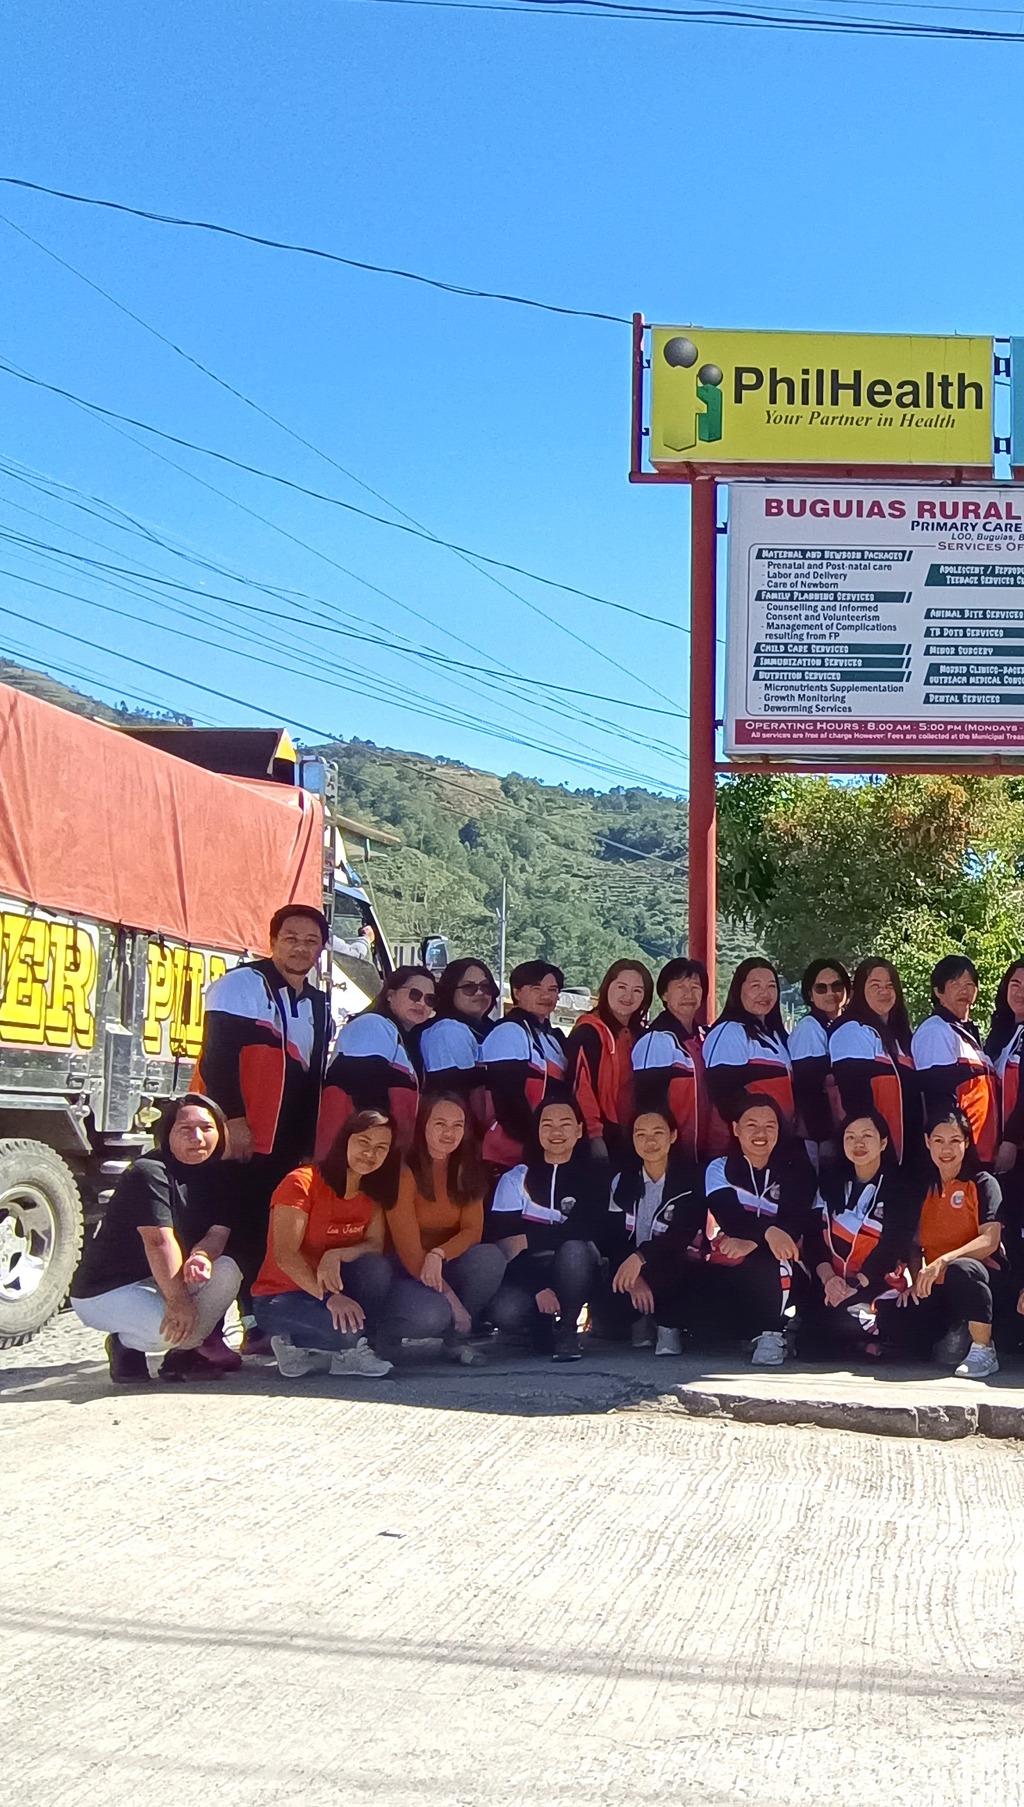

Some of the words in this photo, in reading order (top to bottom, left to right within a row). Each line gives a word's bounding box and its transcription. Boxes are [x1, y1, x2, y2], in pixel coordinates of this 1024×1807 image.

[734, 367, 983, 410] PhilHealth
[765, 410, 803, 425] Your
[808, 411, 873, 427] Partner
[877, 413, 893, 427] in
[900, 413, 956, 429] Health
[764, 498, 906, 519] BUGUIAS
[917, 501, 1021, 521] RURAL
[911, 520, 978, 531] PRIMARY
[982, 521, 1022, 532] CARE
[951, 533, 974, 541] LOO,
[977, 533, 1015, 542] Buguias,
[938, 541, 1002, 551] SERVICES
[767, 561, 805, 570] Prenatal
[807, 562, 824, 570] and
[826, 562, 871, 571] Post-natal
[767, 571, 792, 579] Labor
[794, 571, 811, 579] and
[813, 571, 848, 581] Delivery
[766, 581, 788, 589] Care
[789, 581, 798, 589] of
[800, 581, 839, 589] Newborn
[766, 603, 818, 613] Counselling
[820, 604, 837, 612] and
[838, 604, 879, 612] Informed
[766, 612, 803, 621] Consent
[804, 613, 821, 621] and
[822, 613, 880, 622] Volunteerism
[766, 622, 823, 632] Management
[825, 622, 834, 630] of
[835, 623, 897, 632] Complications
[765, 632, 804, 641] resulting
[806, 632, 827, 640] from
[828, 632, 840, 640] FP
[764, 683, 828, 692] Micronutrients
[830, 684, 904, 693] Supplementation
[764, 694, 795, 702] Growth
[797, 694, 846, 703] Monitoring
[763, 704, 813, 714] Deworming
[815, 704, 852, 713] Services
[745, 721, 814, 730] OPERATING
[816, 722, 859, 730] HOURS
[828, 732, 852, 740] charge
[971, 733, 1004, 741] Municipal
[0, 911, 97, 1050] ER
[142, 940, 227, 1059] PIL
